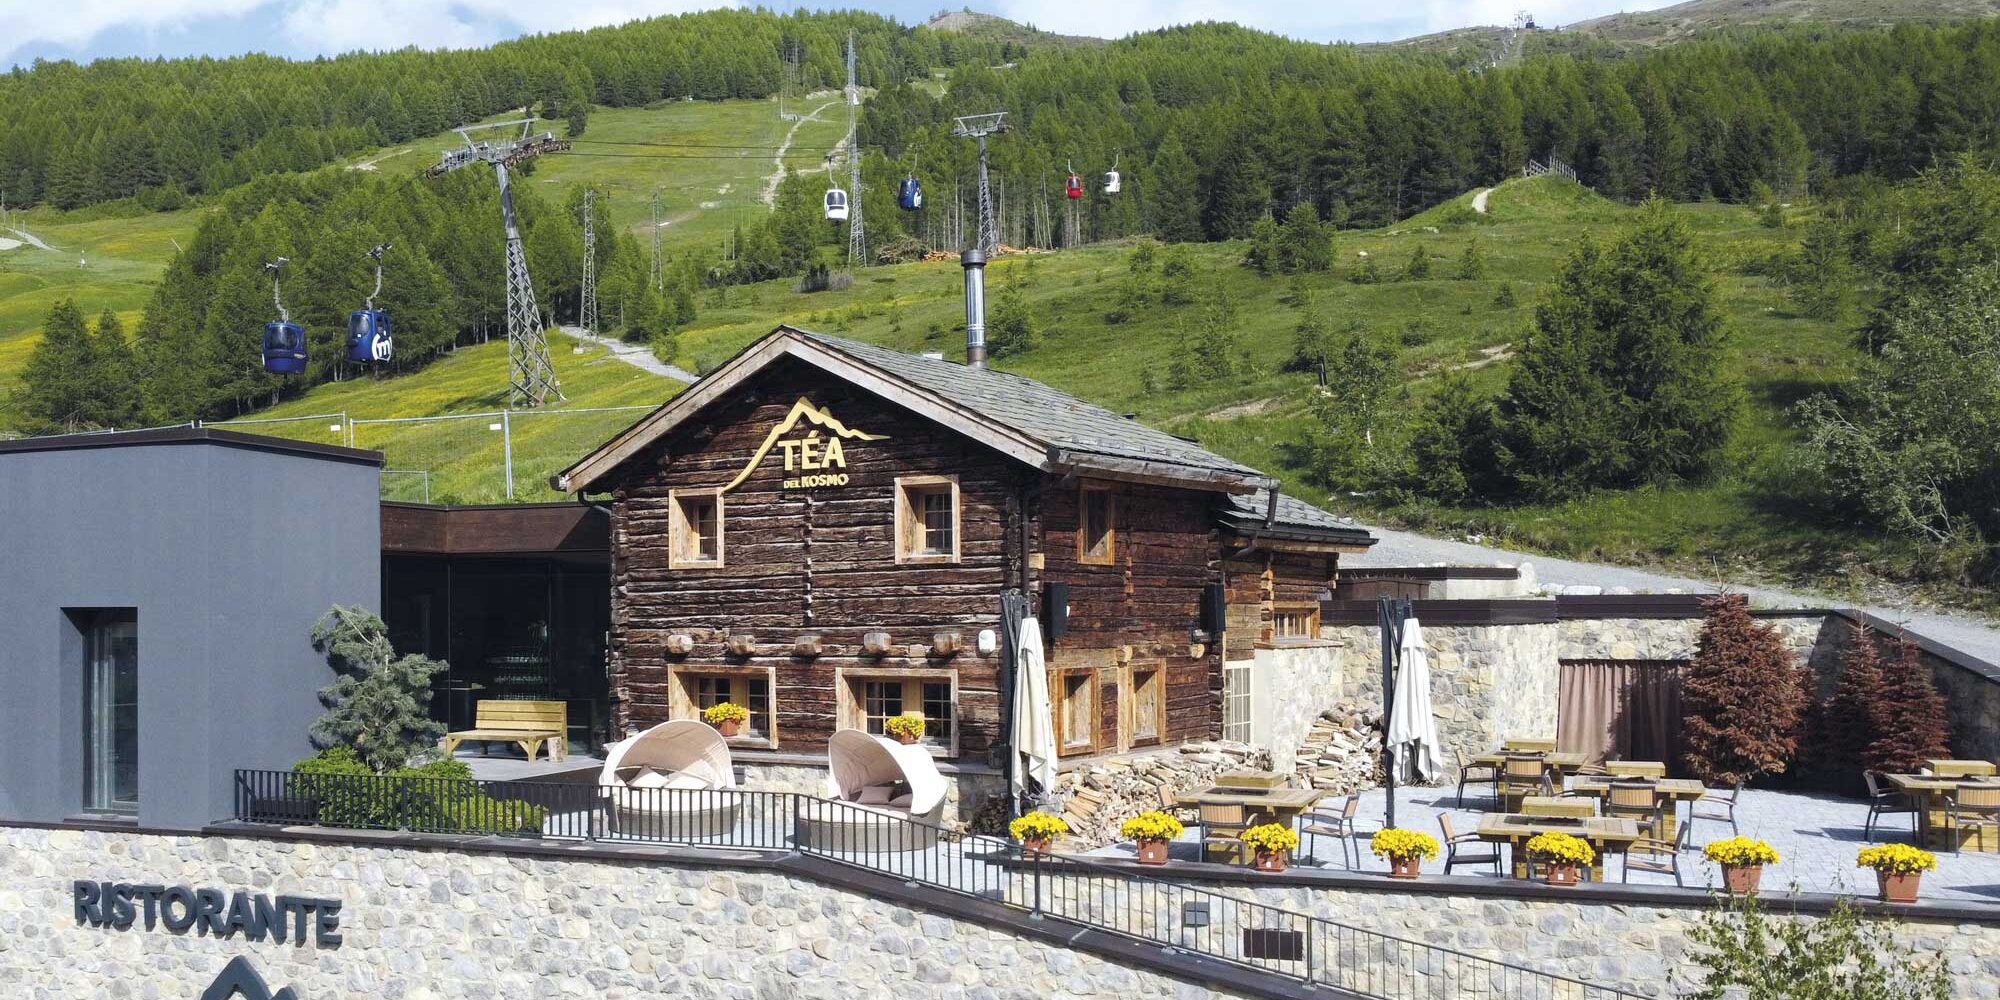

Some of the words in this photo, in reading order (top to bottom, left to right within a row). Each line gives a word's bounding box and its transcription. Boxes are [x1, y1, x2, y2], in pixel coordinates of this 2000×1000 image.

[778, 430, 846, 470] TÉA
[783, 480, 800, 489] DEL
[801, 473, 849, 488] KOSMO
[74, 880, 342, 950] RISTORANTE
